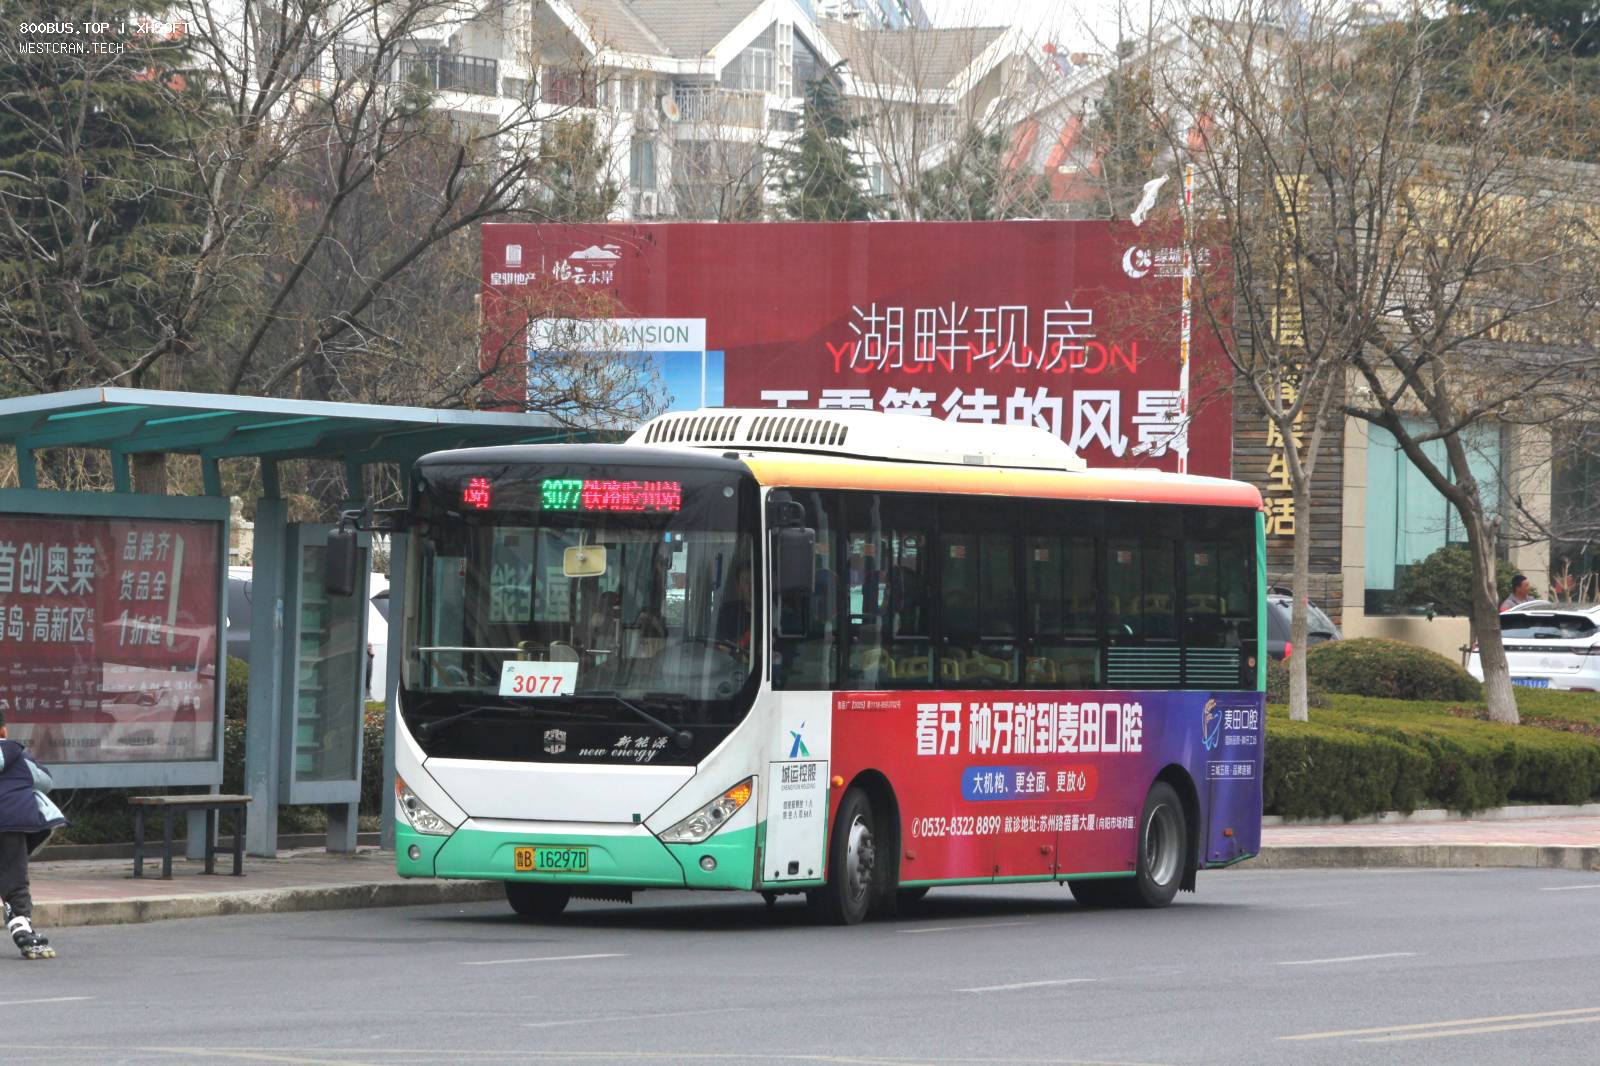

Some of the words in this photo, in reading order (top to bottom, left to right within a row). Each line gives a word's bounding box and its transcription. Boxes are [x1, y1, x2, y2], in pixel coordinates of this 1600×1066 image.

[603, 325, 689, 344] MANSION
[848, 300, 1098, 371] 湖畔现房
[967, 341, 1138, 374] MANSION
[761, 386, 1189, 458] 待的风景
[123, 532, 171, 561] 品牌齐
[0, 541, 96, 595] 首创奥莱
[119, 570, 167, 601] 货品全
[512, 675, 563, 694] 3077
[916, 703, 962, 756] 看牙
[968, 702, 1143, 755] 种牙就到麦田口腔
[1224, 709, 1258, 730] 麦田口腔
[614, 735, 668, 748] 新能源
[579, 748, 606, 756] new
[611, 748, 656, 761] energy
[781, 764, 816, 783] 城运控股
[973, 771, 1087, 795] 大机构、更全面、更放心
[921, 816, 974, 837] 0532-8322
[975, 815, 1001, 835] 8899
[540, 850, 587, 868] 16297D
